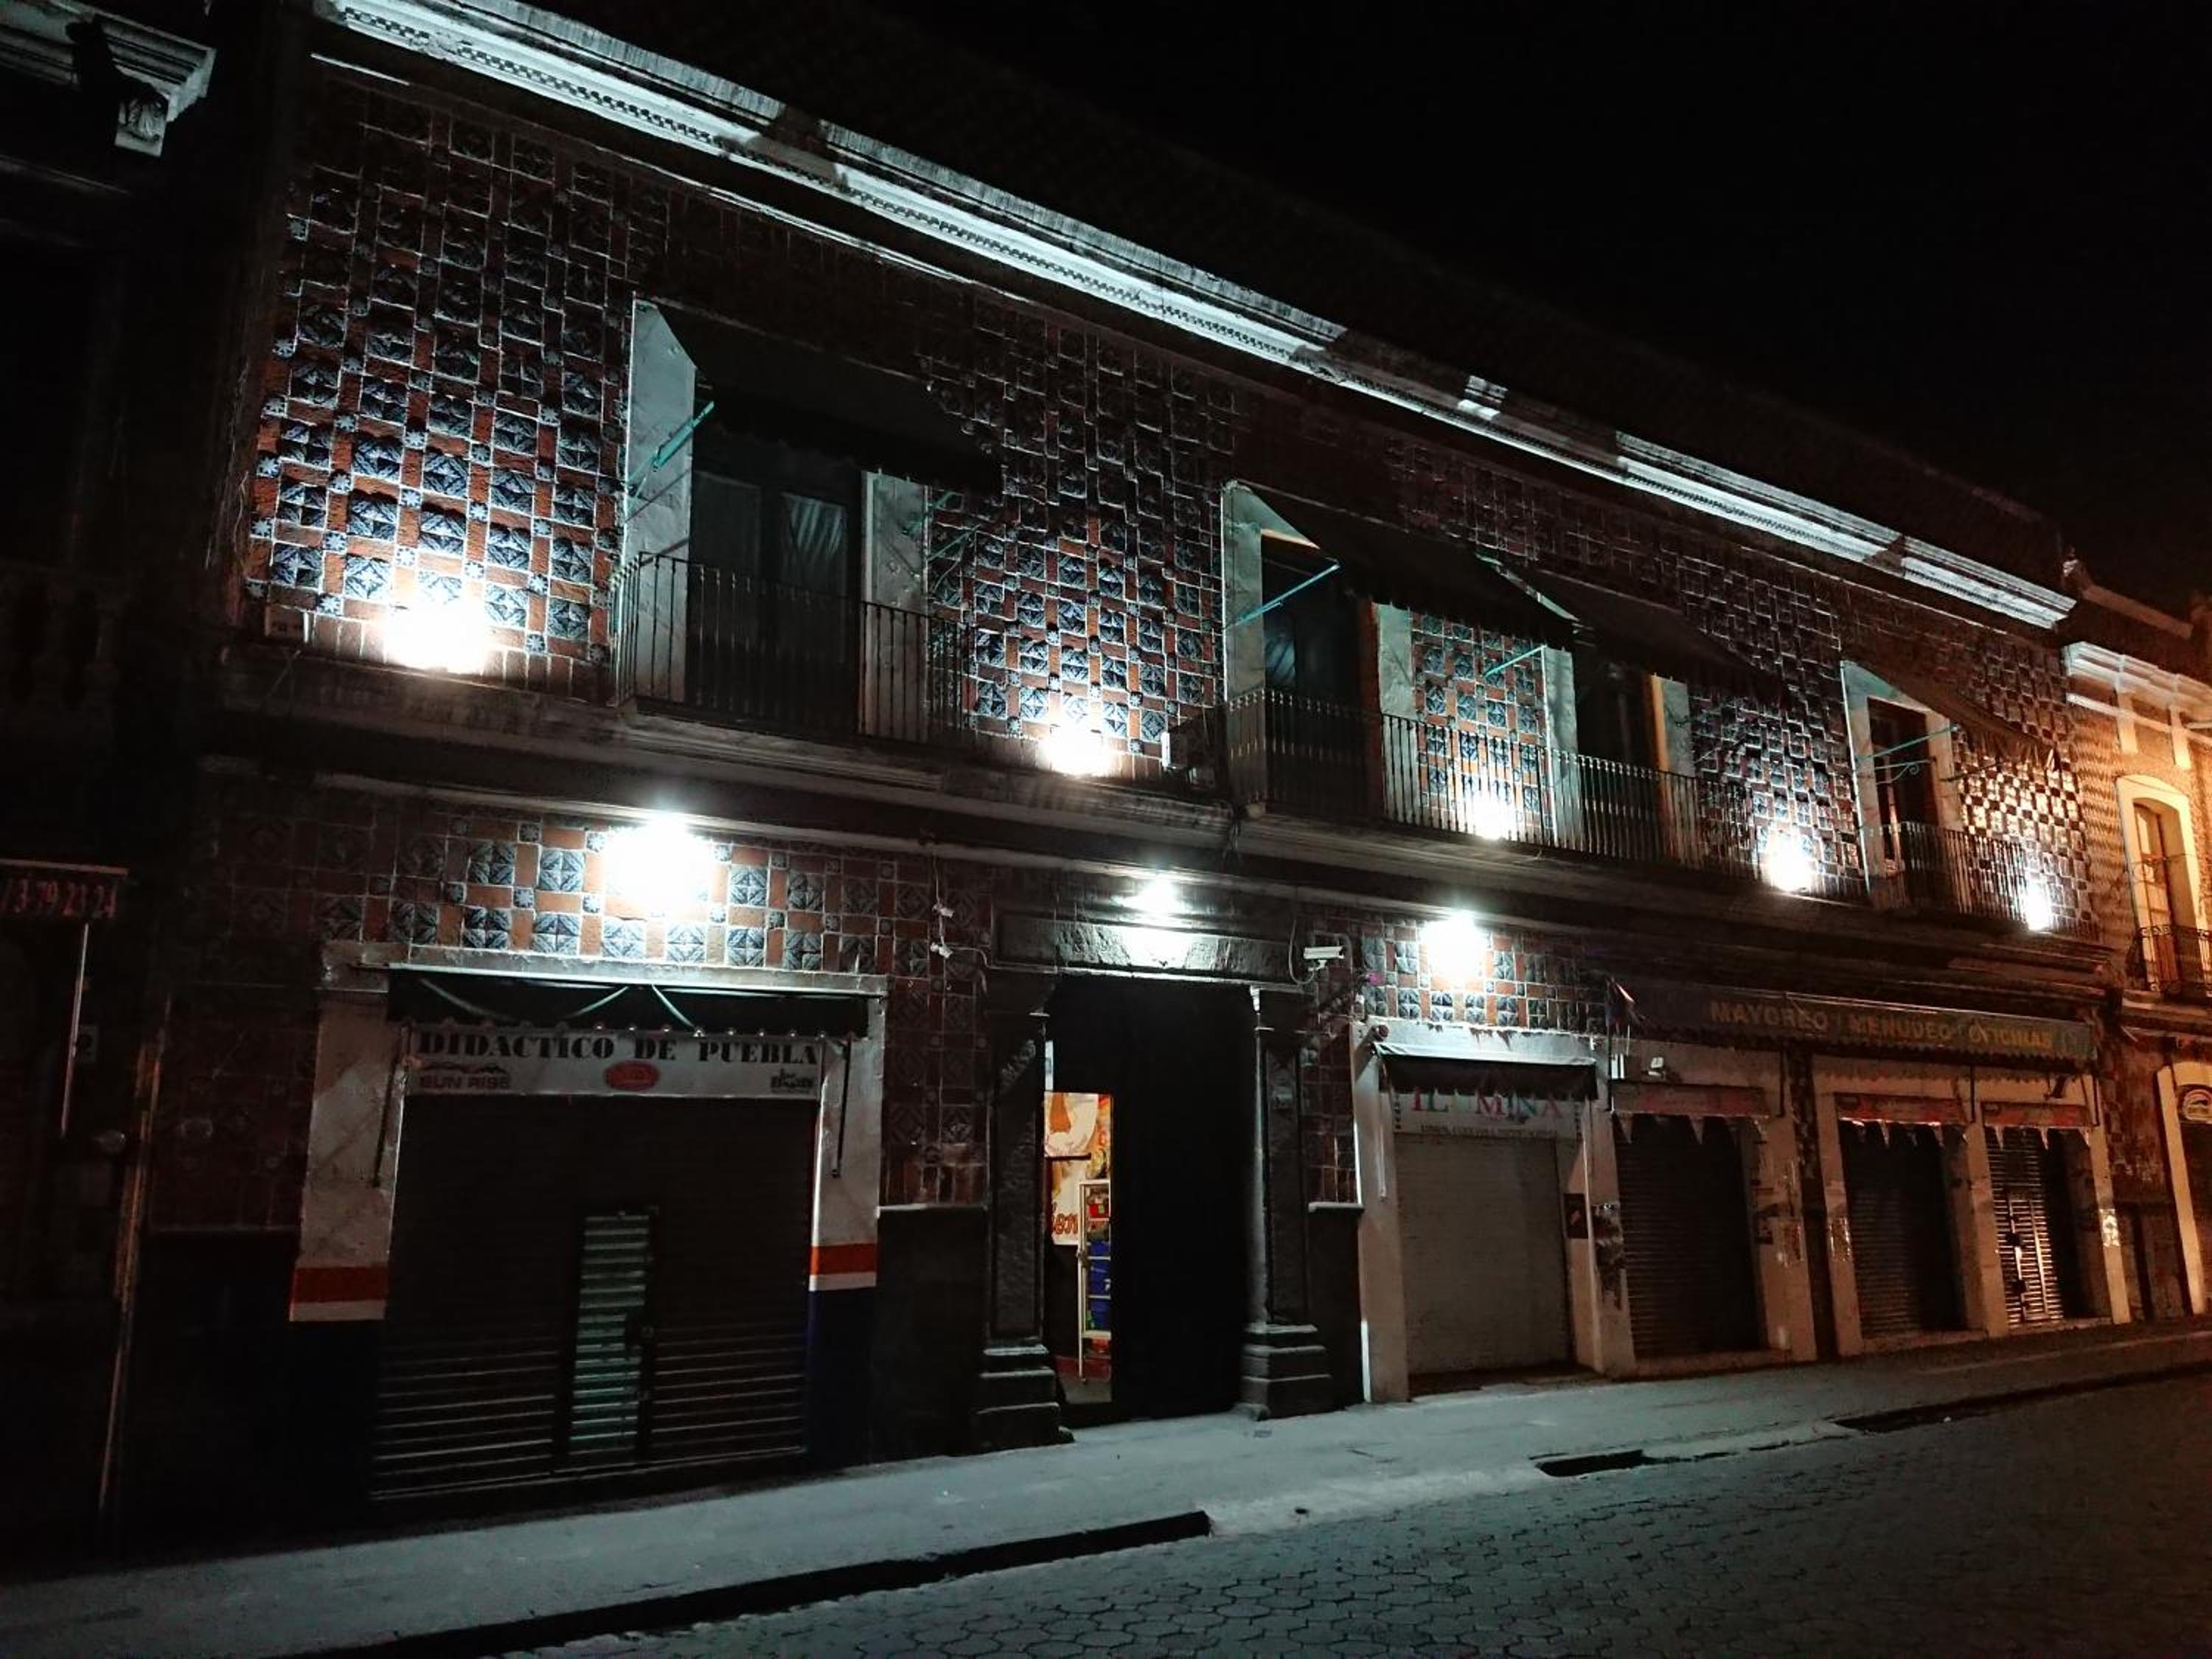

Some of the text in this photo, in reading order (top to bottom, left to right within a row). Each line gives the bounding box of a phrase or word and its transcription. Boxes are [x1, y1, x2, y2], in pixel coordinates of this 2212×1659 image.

[419, 1031, 818, 1064] DIDACTICO DE PUEBLA
